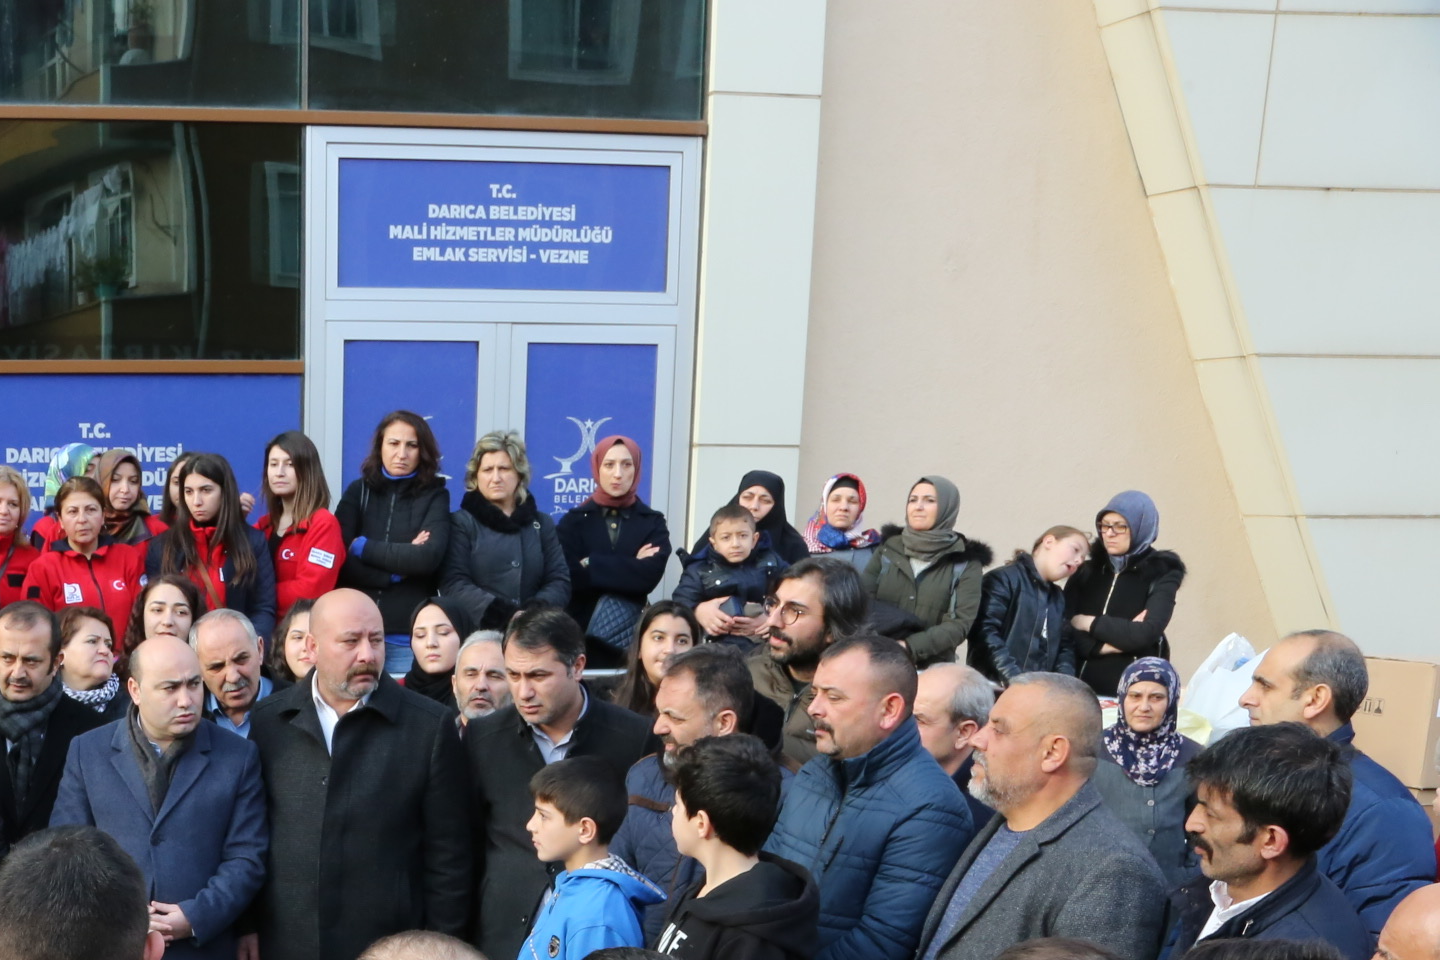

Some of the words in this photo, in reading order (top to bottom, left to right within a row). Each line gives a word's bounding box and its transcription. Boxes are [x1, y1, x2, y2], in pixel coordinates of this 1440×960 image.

[489, 184, 517, 198] T.C.
[428, 204, 486, 219] DARICA
[489, 204, 576, 221] BELEDİYESİ
[389, 223, 427, 240] MALİ
[430, 223, 515, 241] HİZMETLER
[518, 225, 613, 243] MÜDÜRLÜĞÜ
[413, 247, 466, 261] EMLAK
[468, 246, 527, 263] SERVİSİ
[539, 249, 589, 264] VEZNE
[78, 423, 111, 439] T.C.
[5, 447, 61, 464] DARIC
[554, 478, 597, 493] DARI
